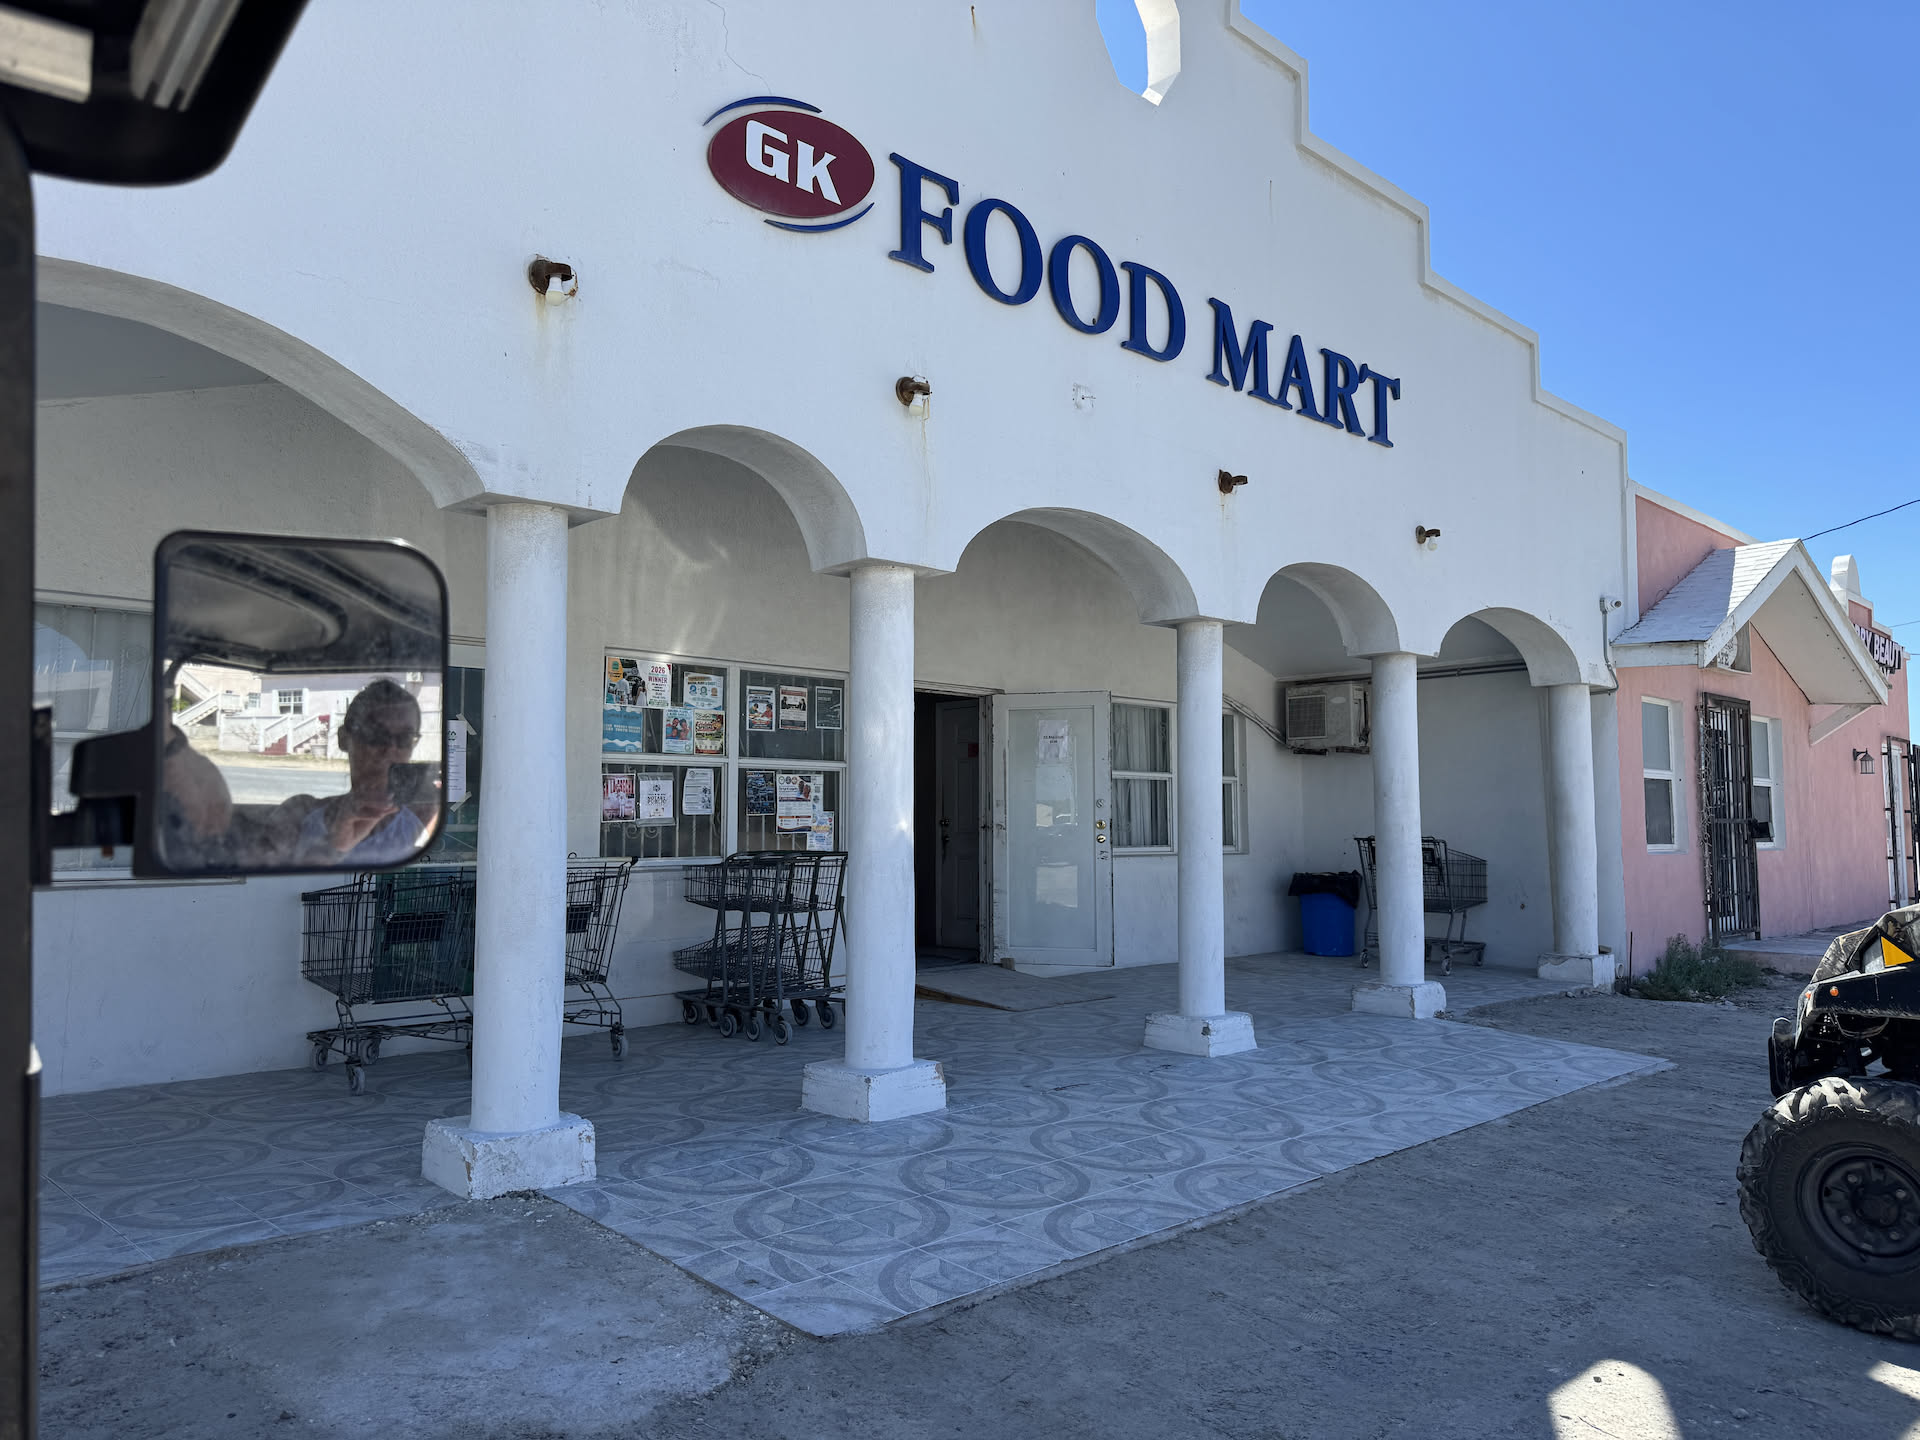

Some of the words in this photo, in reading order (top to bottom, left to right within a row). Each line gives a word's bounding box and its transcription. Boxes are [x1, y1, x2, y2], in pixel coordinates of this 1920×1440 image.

[745, 119, 842, 206] GK
[888, 152, 1186, 362] FOOD
[1206, 297, 1401, 448] MART
[1874, 634, 1905, 669] BEAUTY
[648, 676, 668, 684] WINNER
[650, 665, 666, 674] 2026
